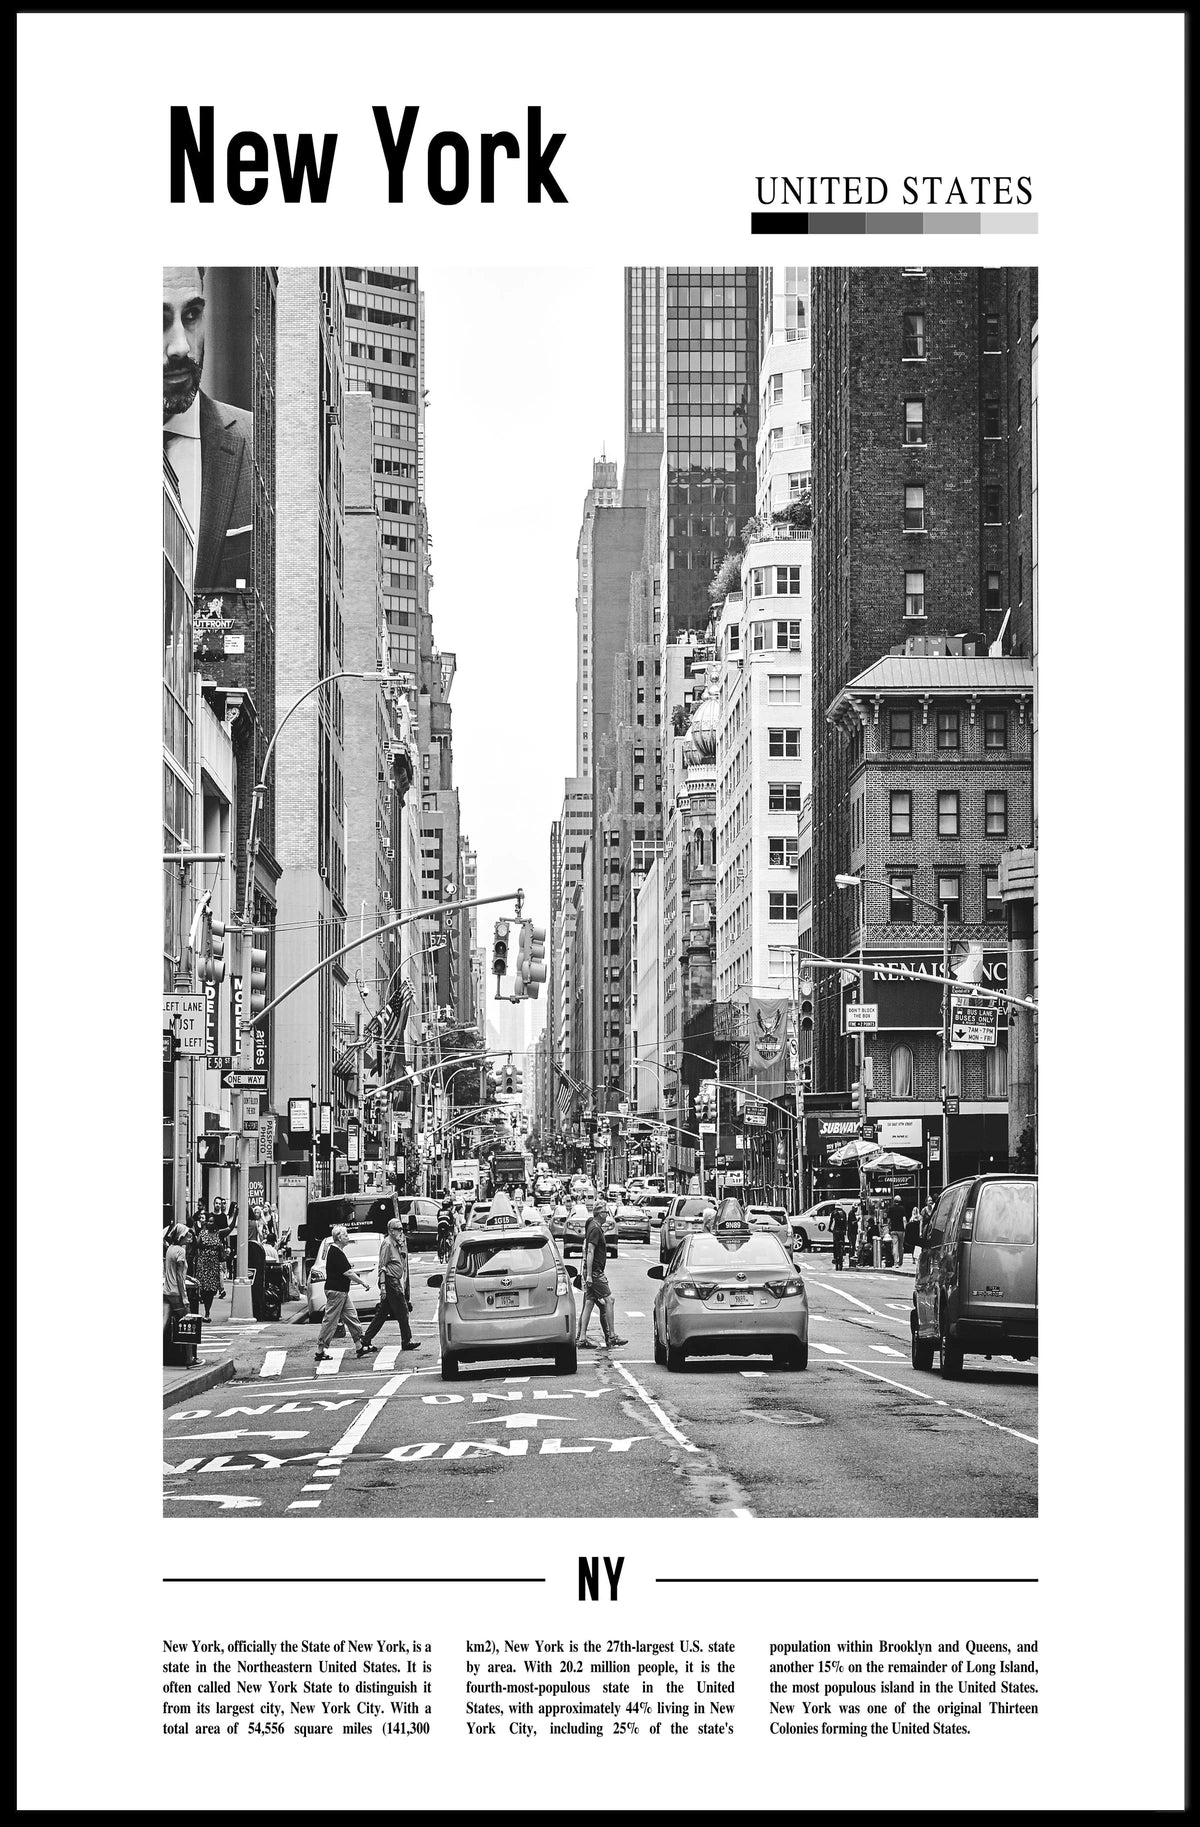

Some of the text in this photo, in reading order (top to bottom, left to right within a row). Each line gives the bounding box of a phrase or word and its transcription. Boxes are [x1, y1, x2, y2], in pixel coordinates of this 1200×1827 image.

[171, 106, 568, 205] New York
[755, 177, 1032, 204] UNITED STATES
[163, 1002, 203, 1011] EFT LANE
[966, 1008, 993, 1017] BUS LANE
[955, 1014, 976, 1022] BUSES
[184, 1037, 203, 1047] LEFT
[207, 1058, 213, 1068] E
[214, 1057, 223, 1068] 58
[227, 1075, 263, 1084] ONE WAY
[820, 1122, 860, 1134] SUBWAY
[249, 1181, 264, 1190] 00%
[249, 1189, 265, 1197] EMY
[494, 1216, 510, 1225] 1G15
[725, 1221, 741, 1229] 9N89
[420, 1387, 615, 1406] ONLY
[167, 1398, 363, 1421] ONLY
[384, 1436, 652, 1461] ONLY
[579, 1557, 625, 1601] NY
[162, 1639, 431, 1655] New York, officially the State of New York, is a
[466, 1639, 735, 1655] km2), New York is the 27th-largest U.S. state
[769, 1639, 1038, 1655] population within Brooklyn and Queens, and
[162, 1660, 431, 1673] state in the Northeastern United States. It is
[466, 1660, 735, 1676] by area. With 20.2 million people, it is the
[769, 1660, 1038, 1676] another 15% on the remainder of Long Island,
[162, 1680, 431, 1696] often called New York State to distinguish it
[466, 1680, 734, 1696] fourth-most-populous state in the United
[769, 1680, 1038, 1696] the most populous island in the United States.
[162, 1701, 431, 1717] from its largest city, New York City. With a
[465, 1701, 735, 1717] States, with approximately 44% living in New
[769, 1701, 1038, 1717] New York was one of the original Thirteen
[162, 1721, 430, 1737] total area of 54,556 square miles (141,300
[466, 1721, 733, 1737] York City, including 25% of the state's
[769, 1721, 970, 1737] Colonies forming the United States.
